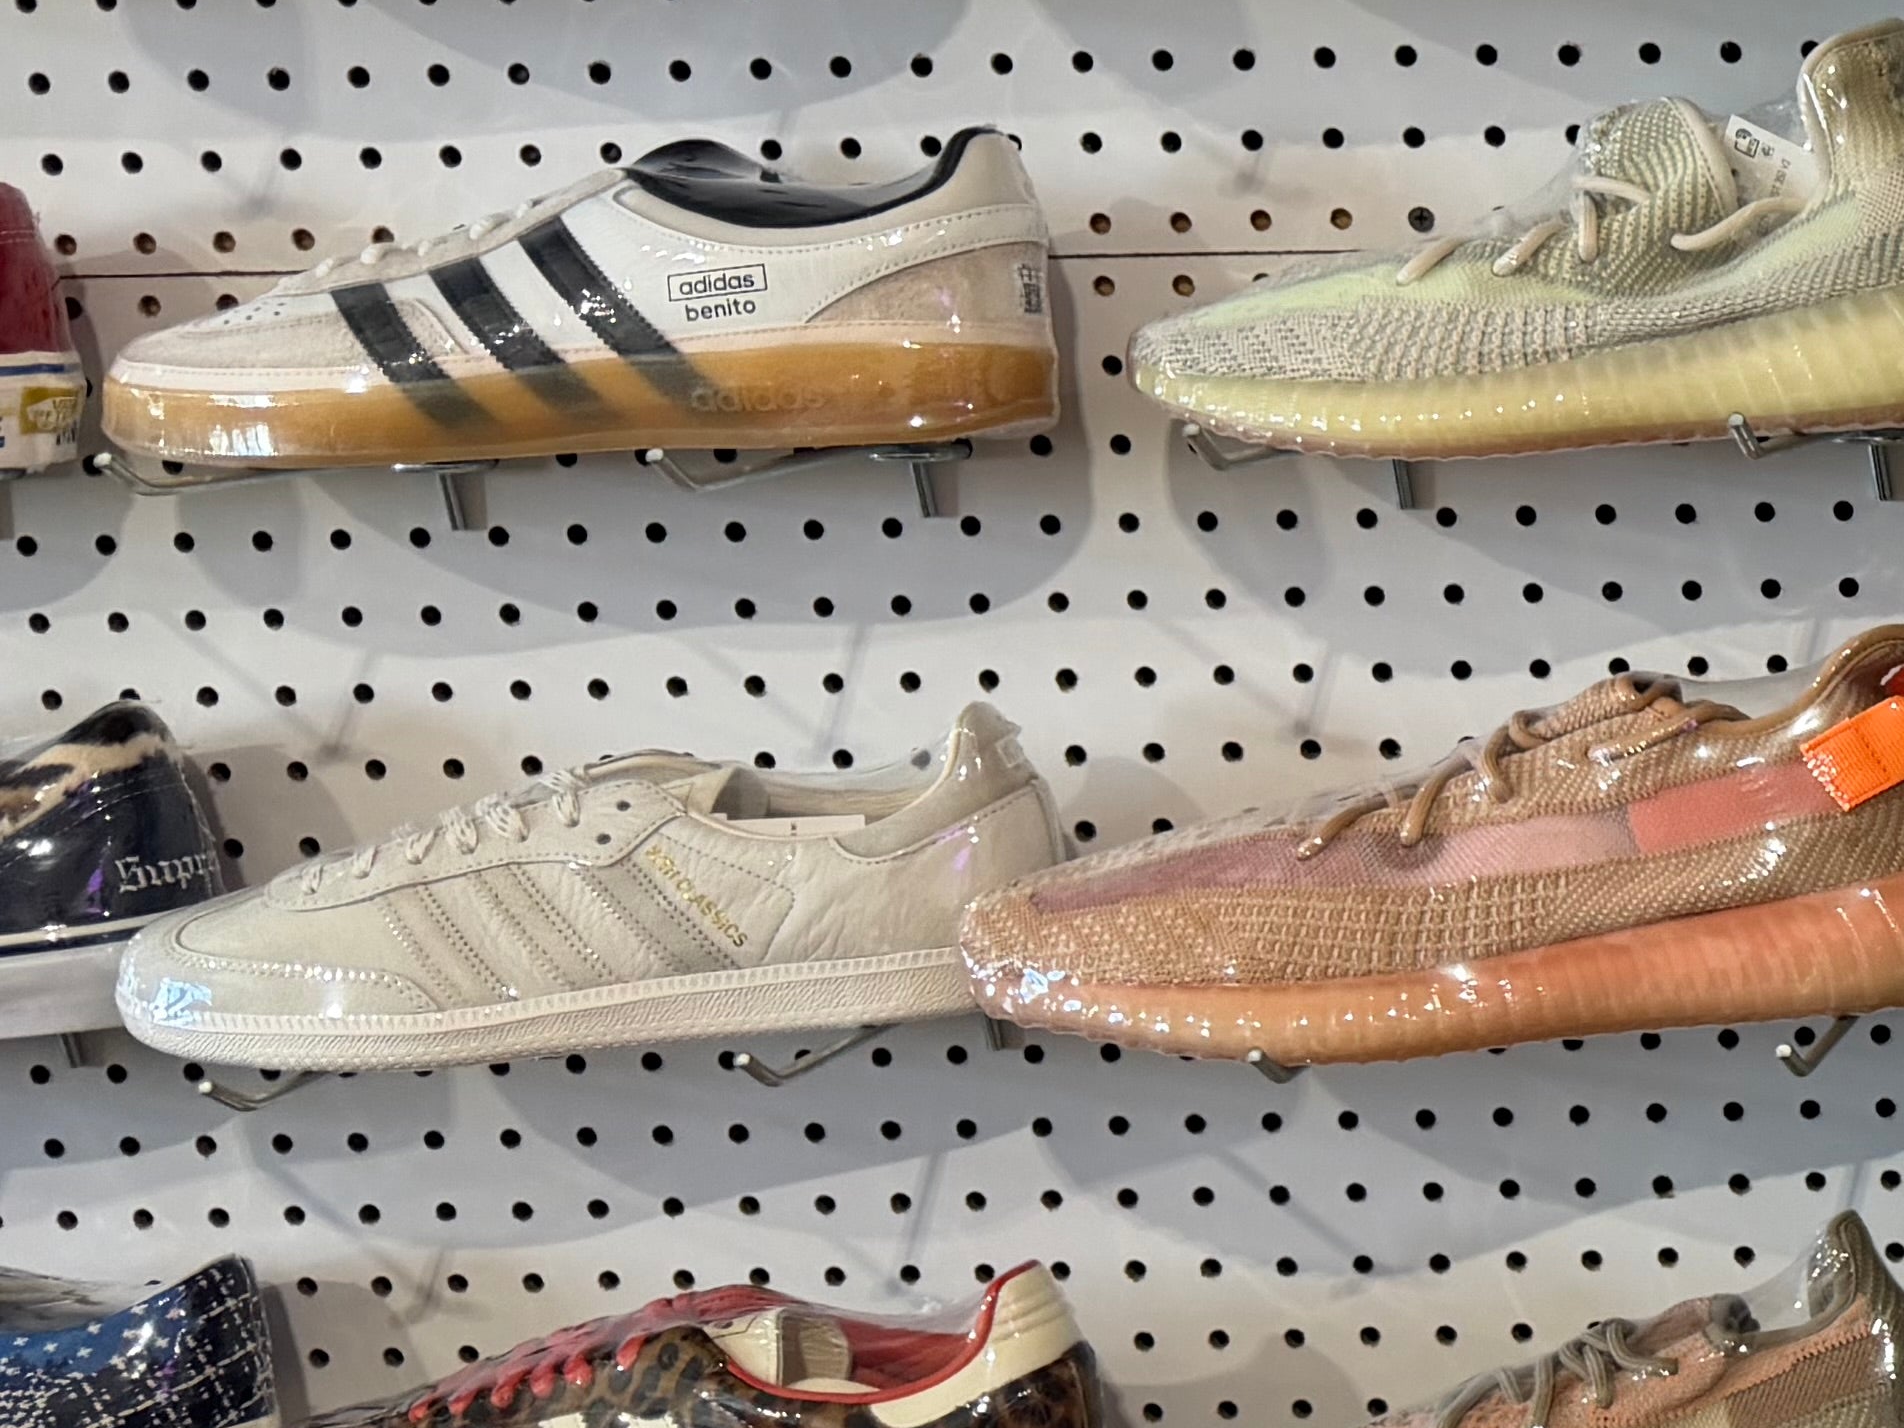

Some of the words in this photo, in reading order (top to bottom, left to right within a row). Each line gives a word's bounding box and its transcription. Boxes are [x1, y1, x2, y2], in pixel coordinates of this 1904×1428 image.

[679, 271, 755, 296] adidas
[685, 298, 757, 322] benito
[690, 381, 827, 413] adidas
